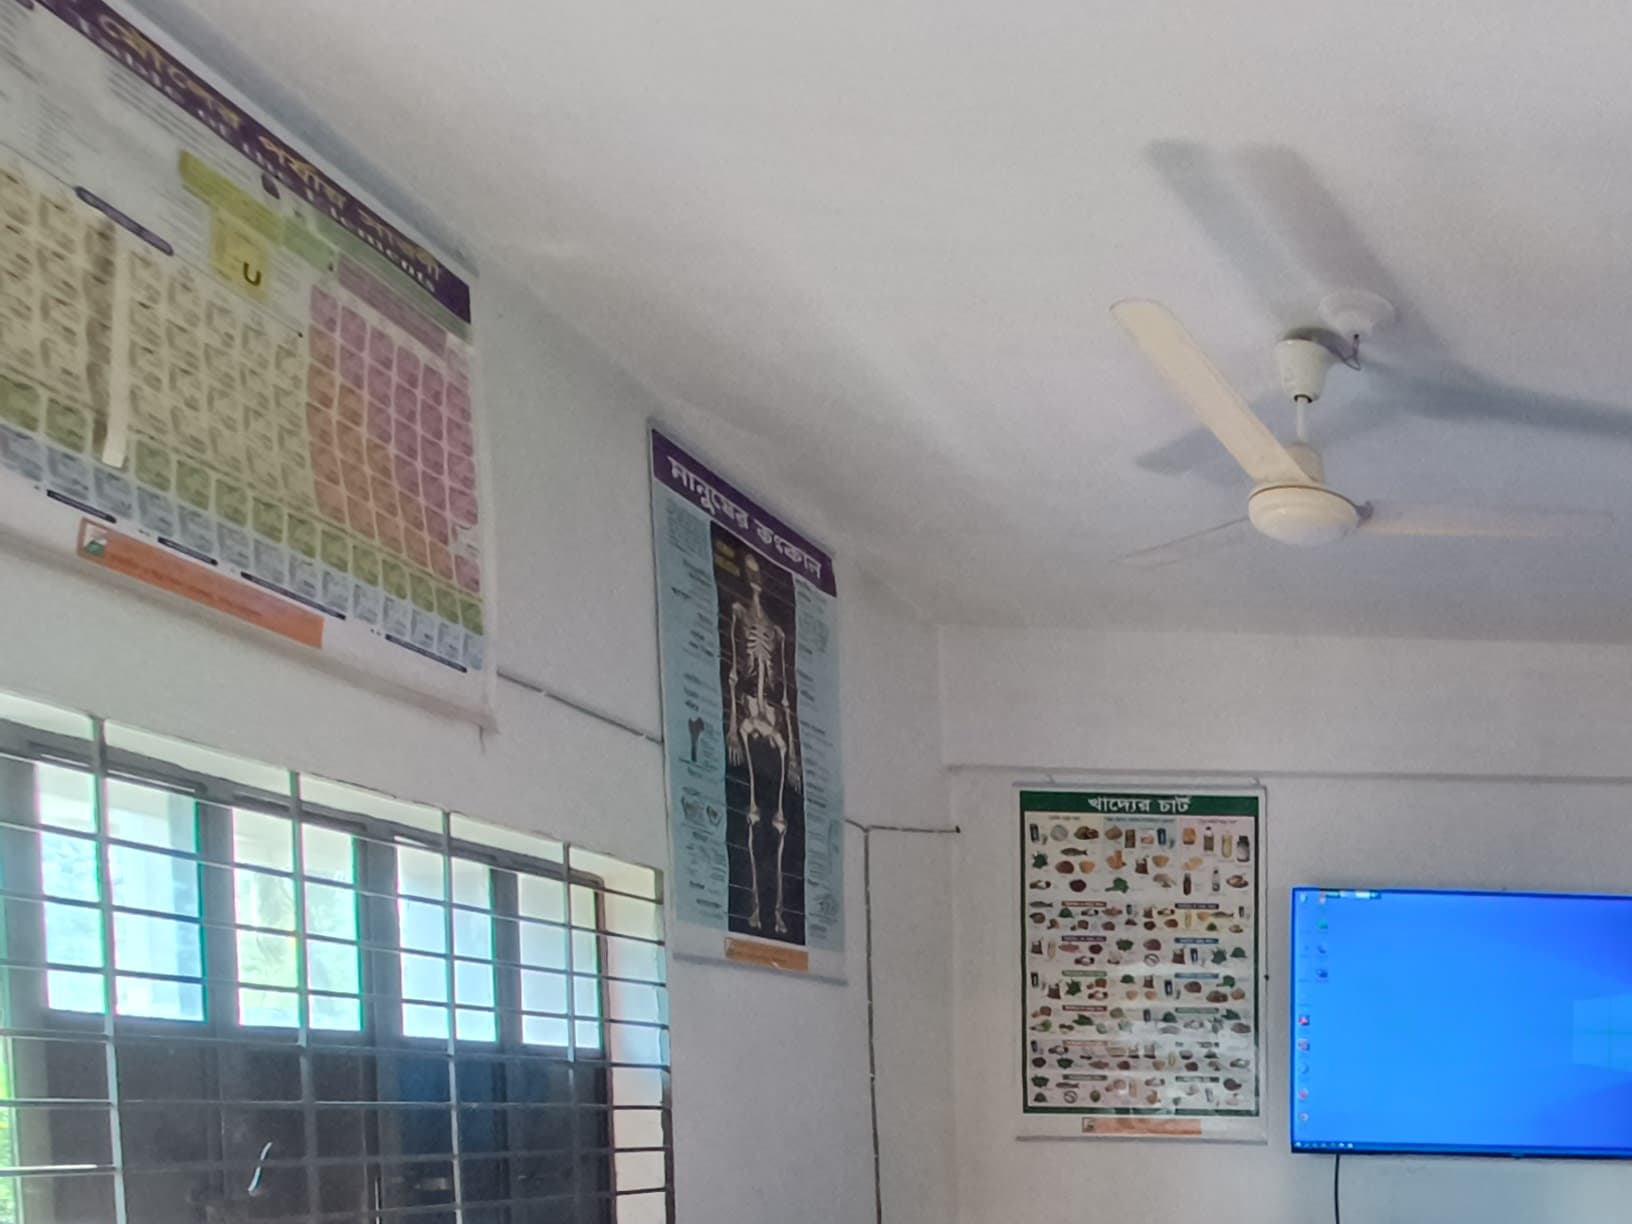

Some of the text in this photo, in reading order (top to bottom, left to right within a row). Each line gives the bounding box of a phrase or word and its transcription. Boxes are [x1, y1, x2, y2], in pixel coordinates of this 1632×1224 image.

[666, 455, 750, 530] মানুষের
[1087, 795, 1192, 813] খাদ্যের চার্ট
